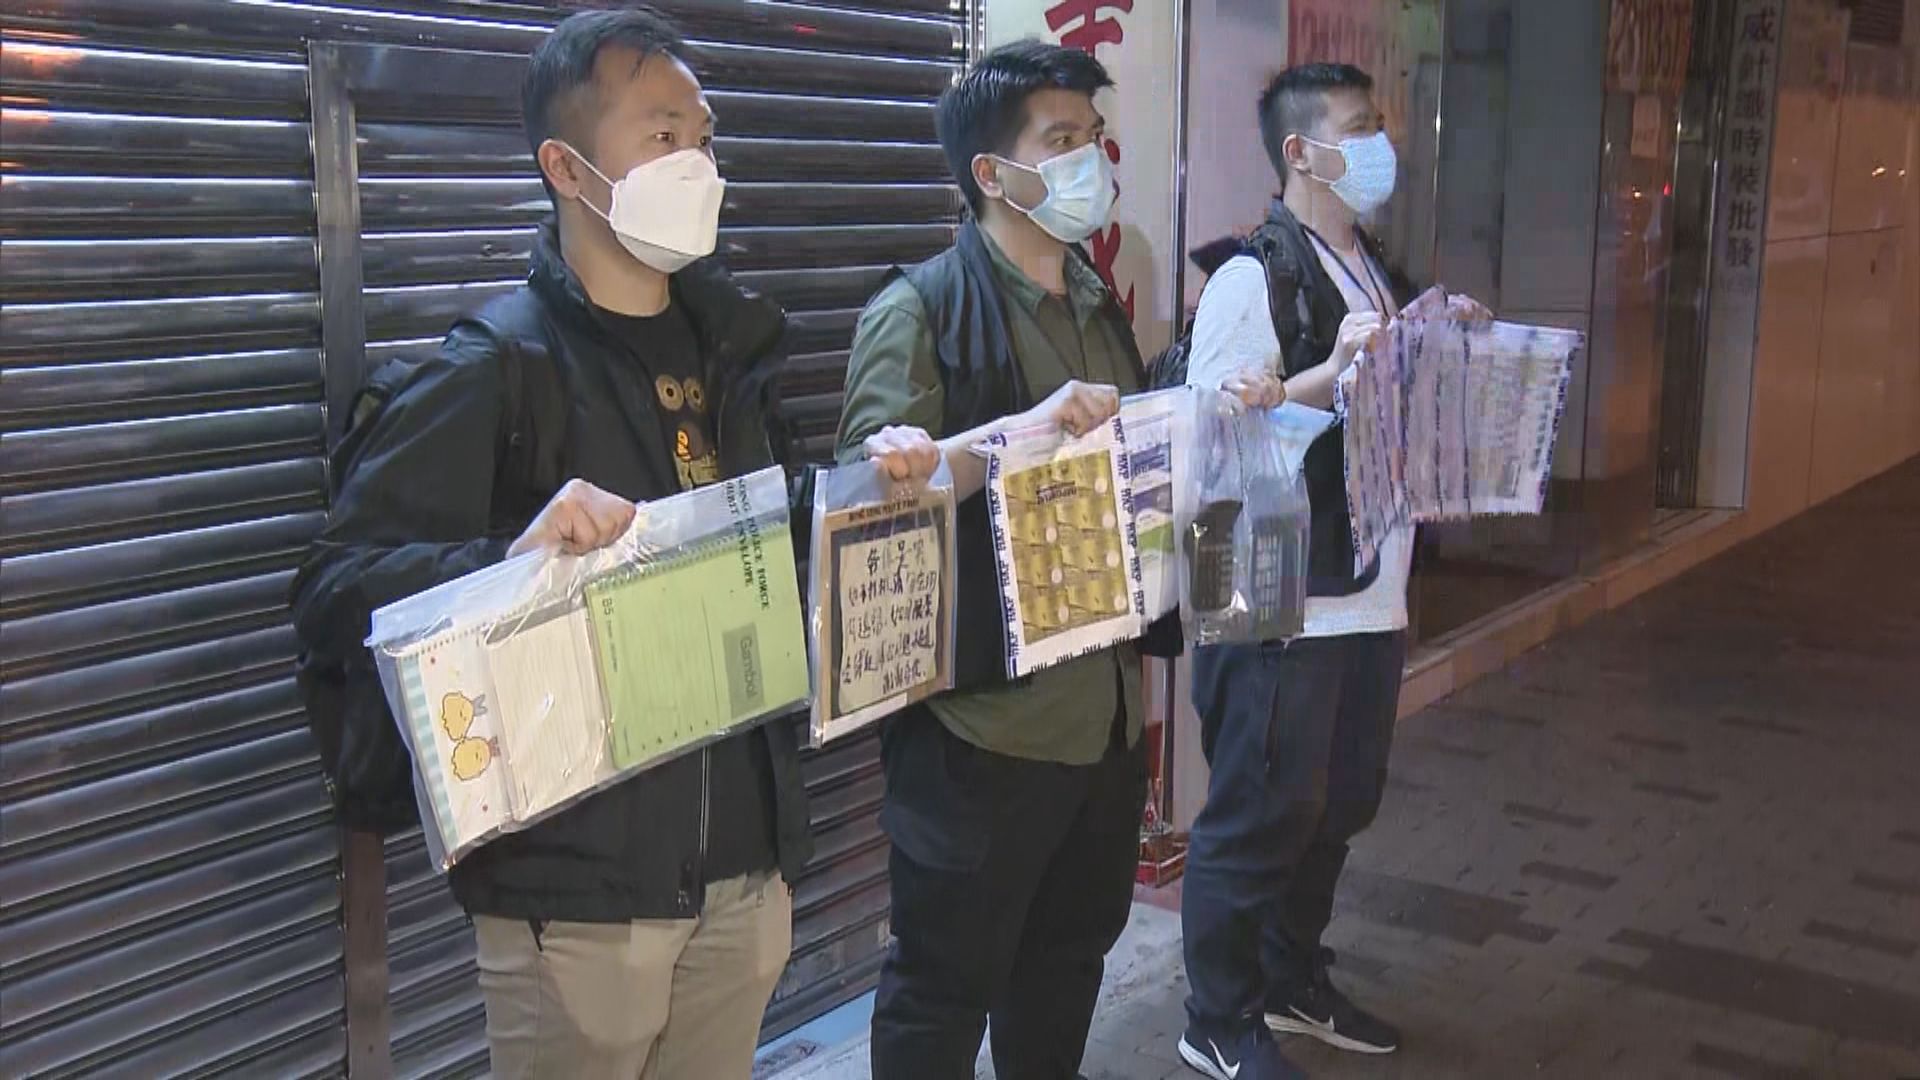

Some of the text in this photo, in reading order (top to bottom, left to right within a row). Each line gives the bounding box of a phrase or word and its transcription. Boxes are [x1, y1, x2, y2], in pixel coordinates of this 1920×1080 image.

[1112, 417, 1125, 443] HKP
[989, 454, 1000, 479] HKP
[1118, 452, 1129, 479] HKP
[990, 490, 1001, 515] HKP
[1121, 488, 1134, 514] HKP
[994, 524, 1006, 551] HKP
[1125, 522, 1137, 549] HKP
[747, 516, 762, 562] POLICE
[757, 568, 770, 610] FORCE
[1000, 560, 1010, 587] HKP
[1130, 556, 1141, 582] HKP
[1005, 596, 1016, 622] HKP
[1133, 590, 1145, 615] HKP
[1010, 631, 1020, 657] HKP
